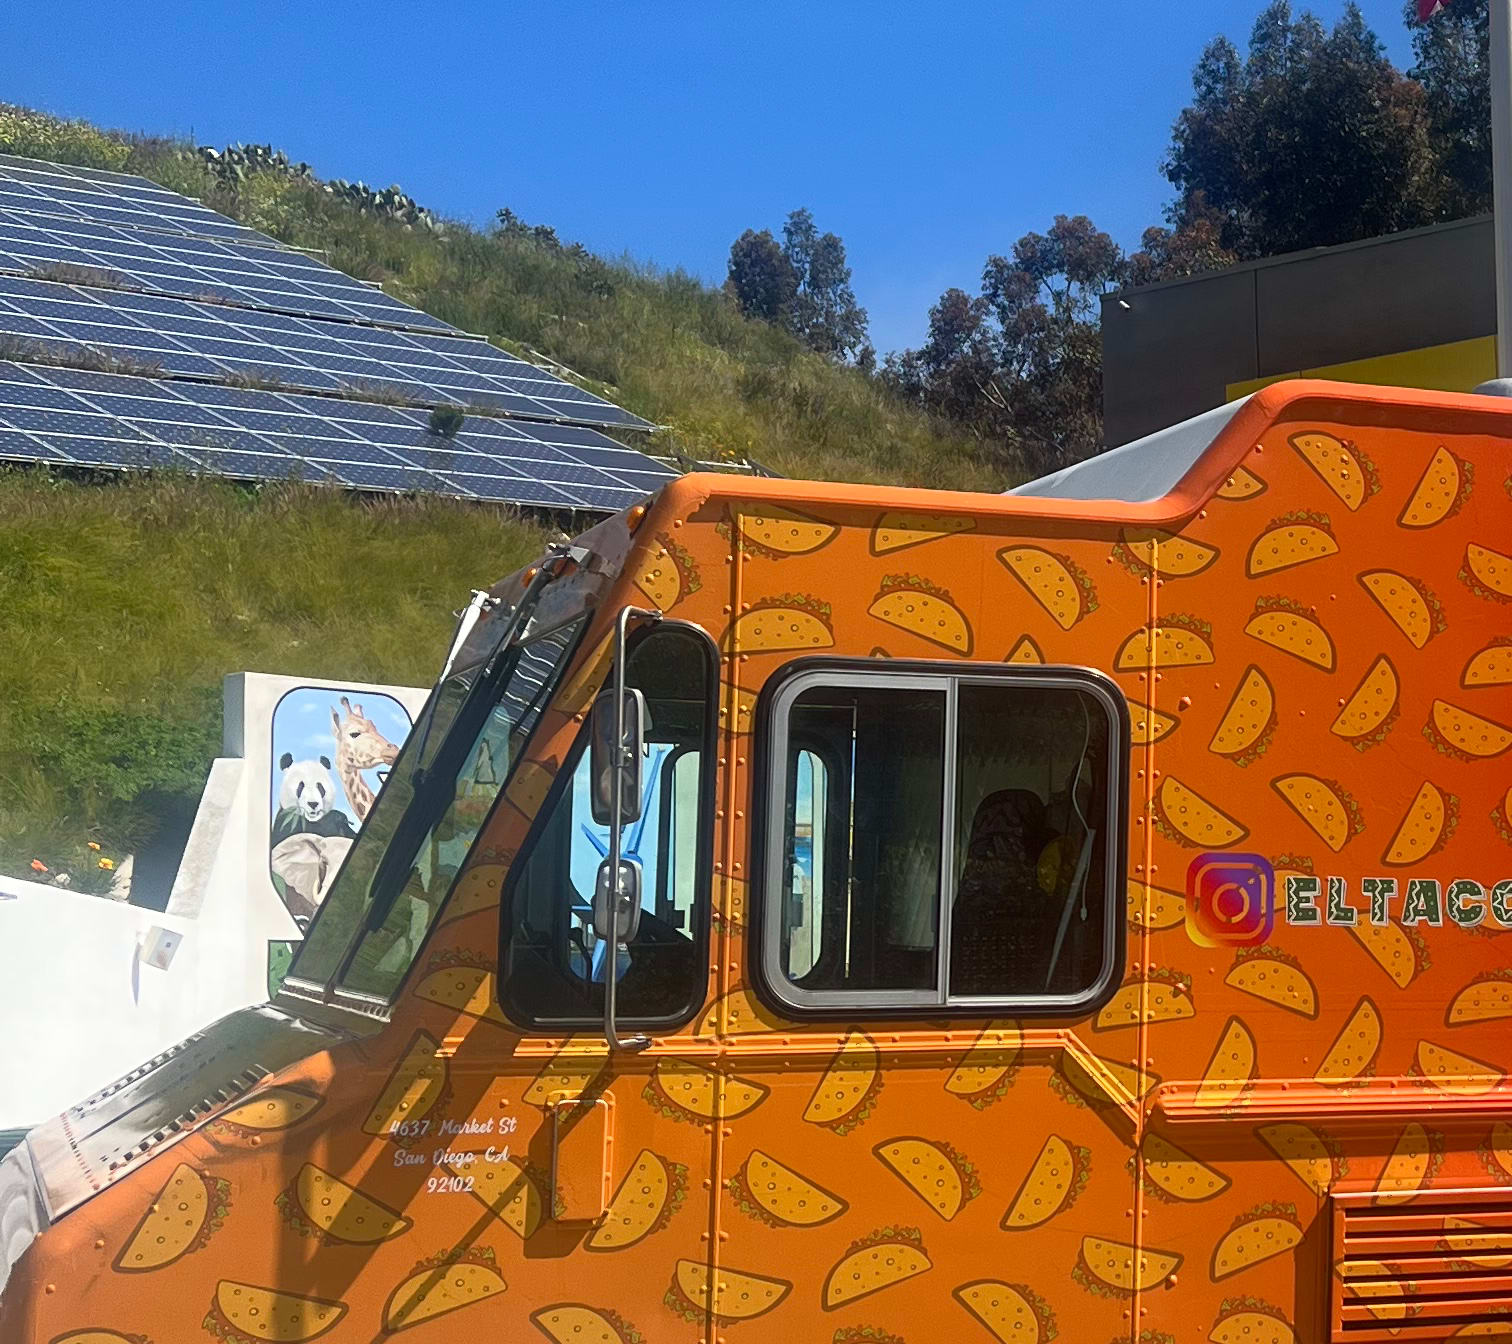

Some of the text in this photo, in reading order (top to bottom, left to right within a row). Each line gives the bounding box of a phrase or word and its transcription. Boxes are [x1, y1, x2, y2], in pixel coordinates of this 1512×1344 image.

[389, 1116, 518, 1136] 4637 Market St
[393, 1144, 511, 1168] San Diego, CA
[426, 1175, 475, 1194] 92102
